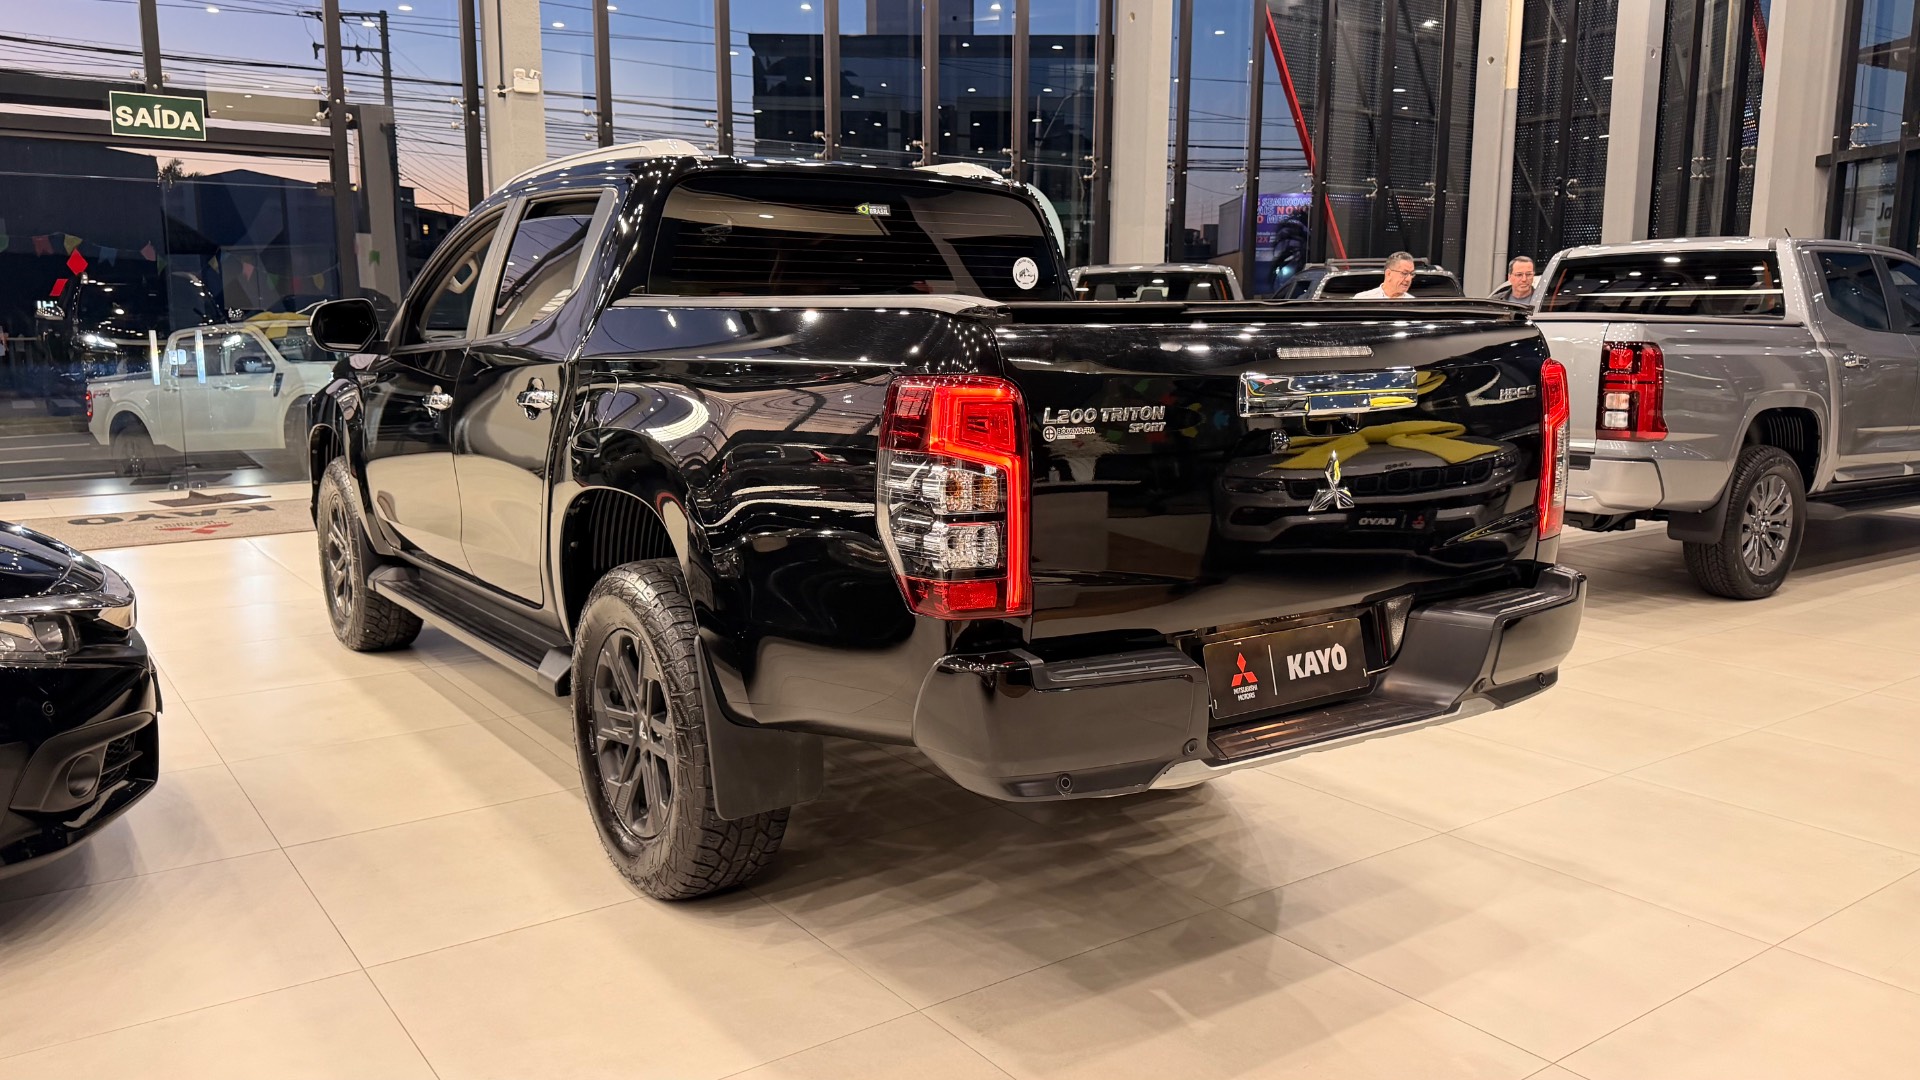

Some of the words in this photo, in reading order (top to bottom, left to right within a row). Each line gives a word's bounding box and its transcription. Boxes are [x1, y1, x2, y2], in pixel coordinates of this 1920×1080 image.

[115, 104, 201, 132] SAÍDA
[1257, 206, 1275, 215] AIS
[1499, 384, 1537, 400] HPES
[1043, 407, 1098, 425] L200
[1100, 406, 1166, 423] TRITON
[1128, 421, 1167, 433] SPORT
[1286, 643, 1348, 681] KAYÔ
[1237, 692, 1256, 702] MOTORS
